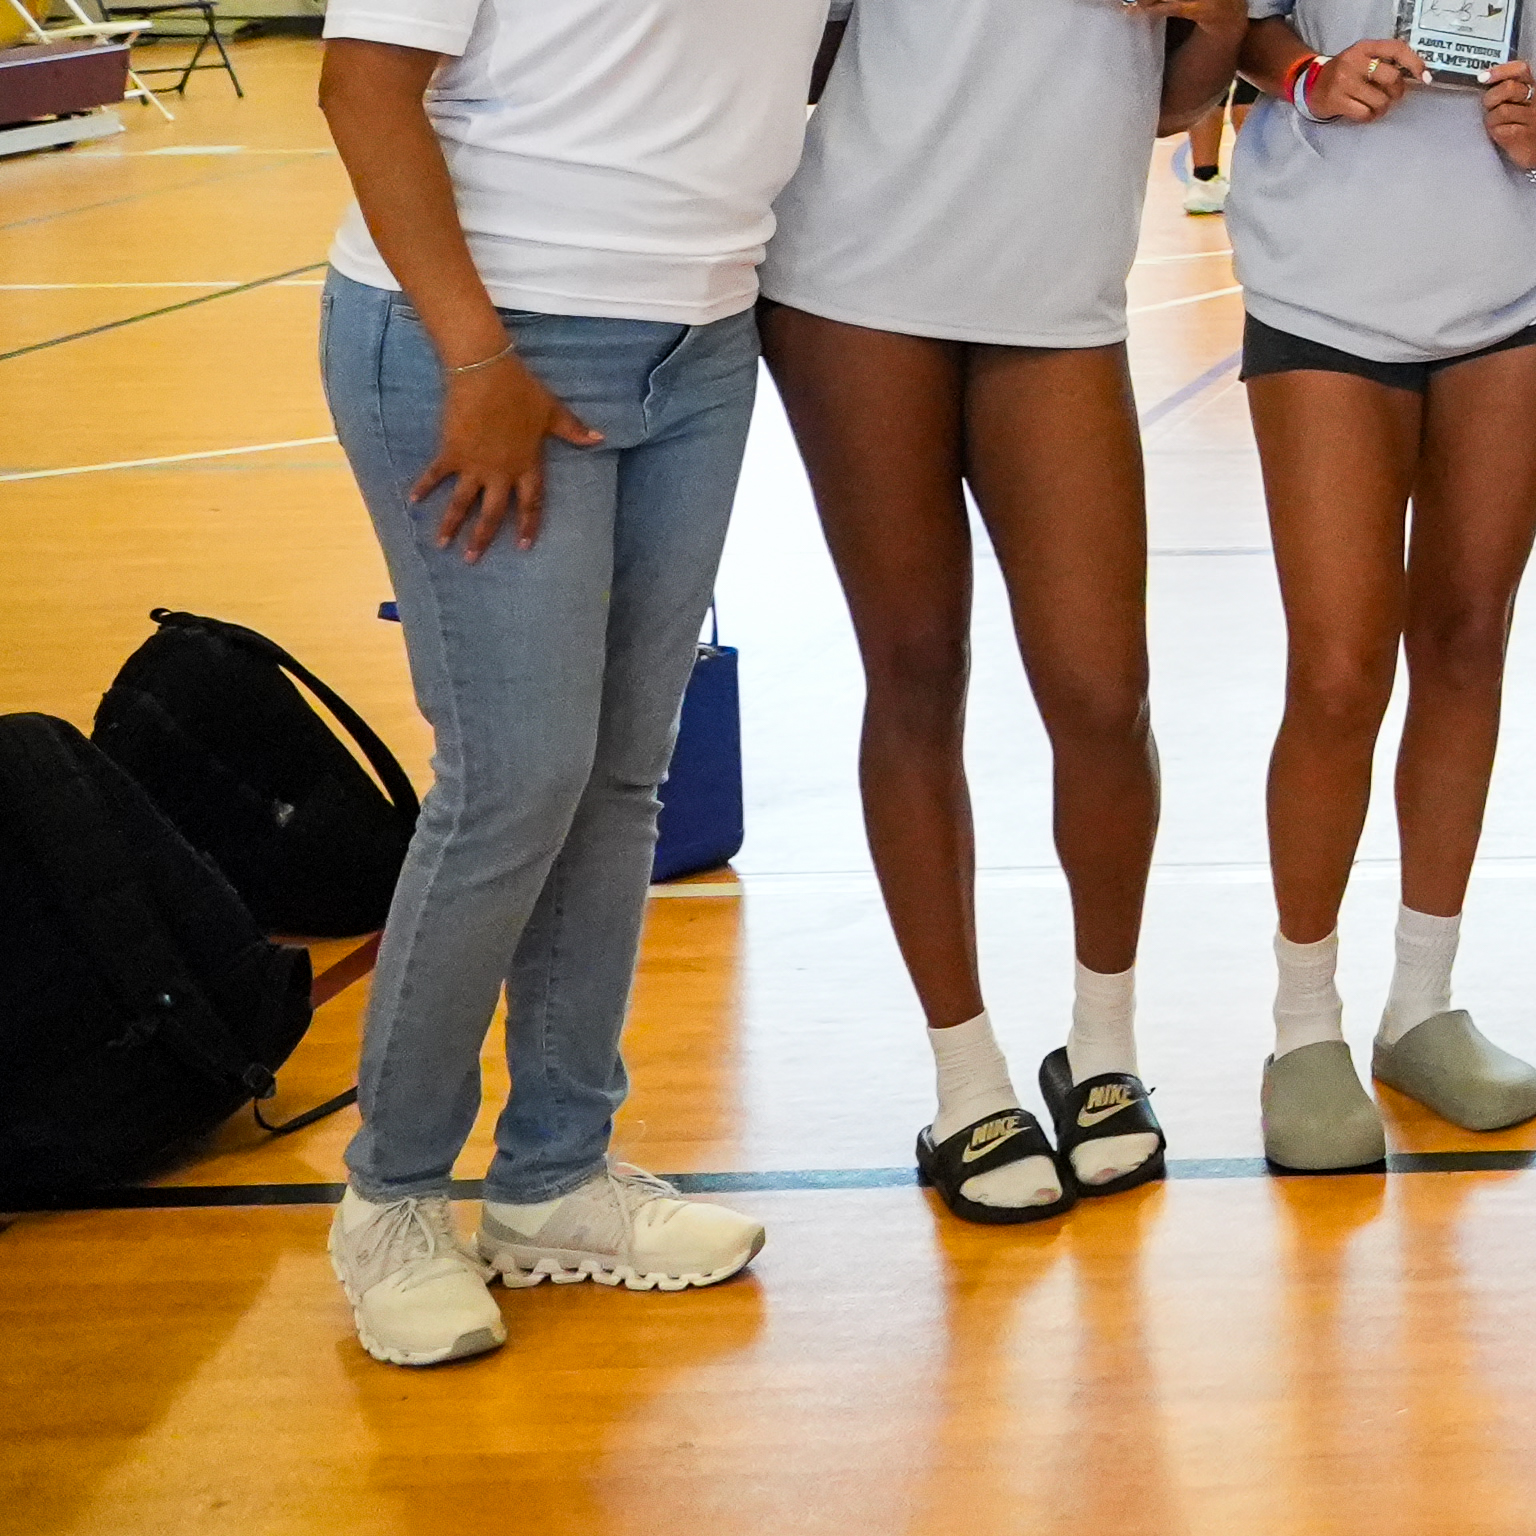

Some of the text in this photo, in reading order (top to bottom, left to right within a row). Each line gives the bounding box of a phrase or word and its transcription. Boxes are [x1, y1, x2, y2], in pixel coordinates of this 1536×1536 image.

[1418, 37, 1452, 50] ADULT
[1086, 1084, 1132, 1111] NIKE
[970, 1116, 1021, 1149] NIKE
